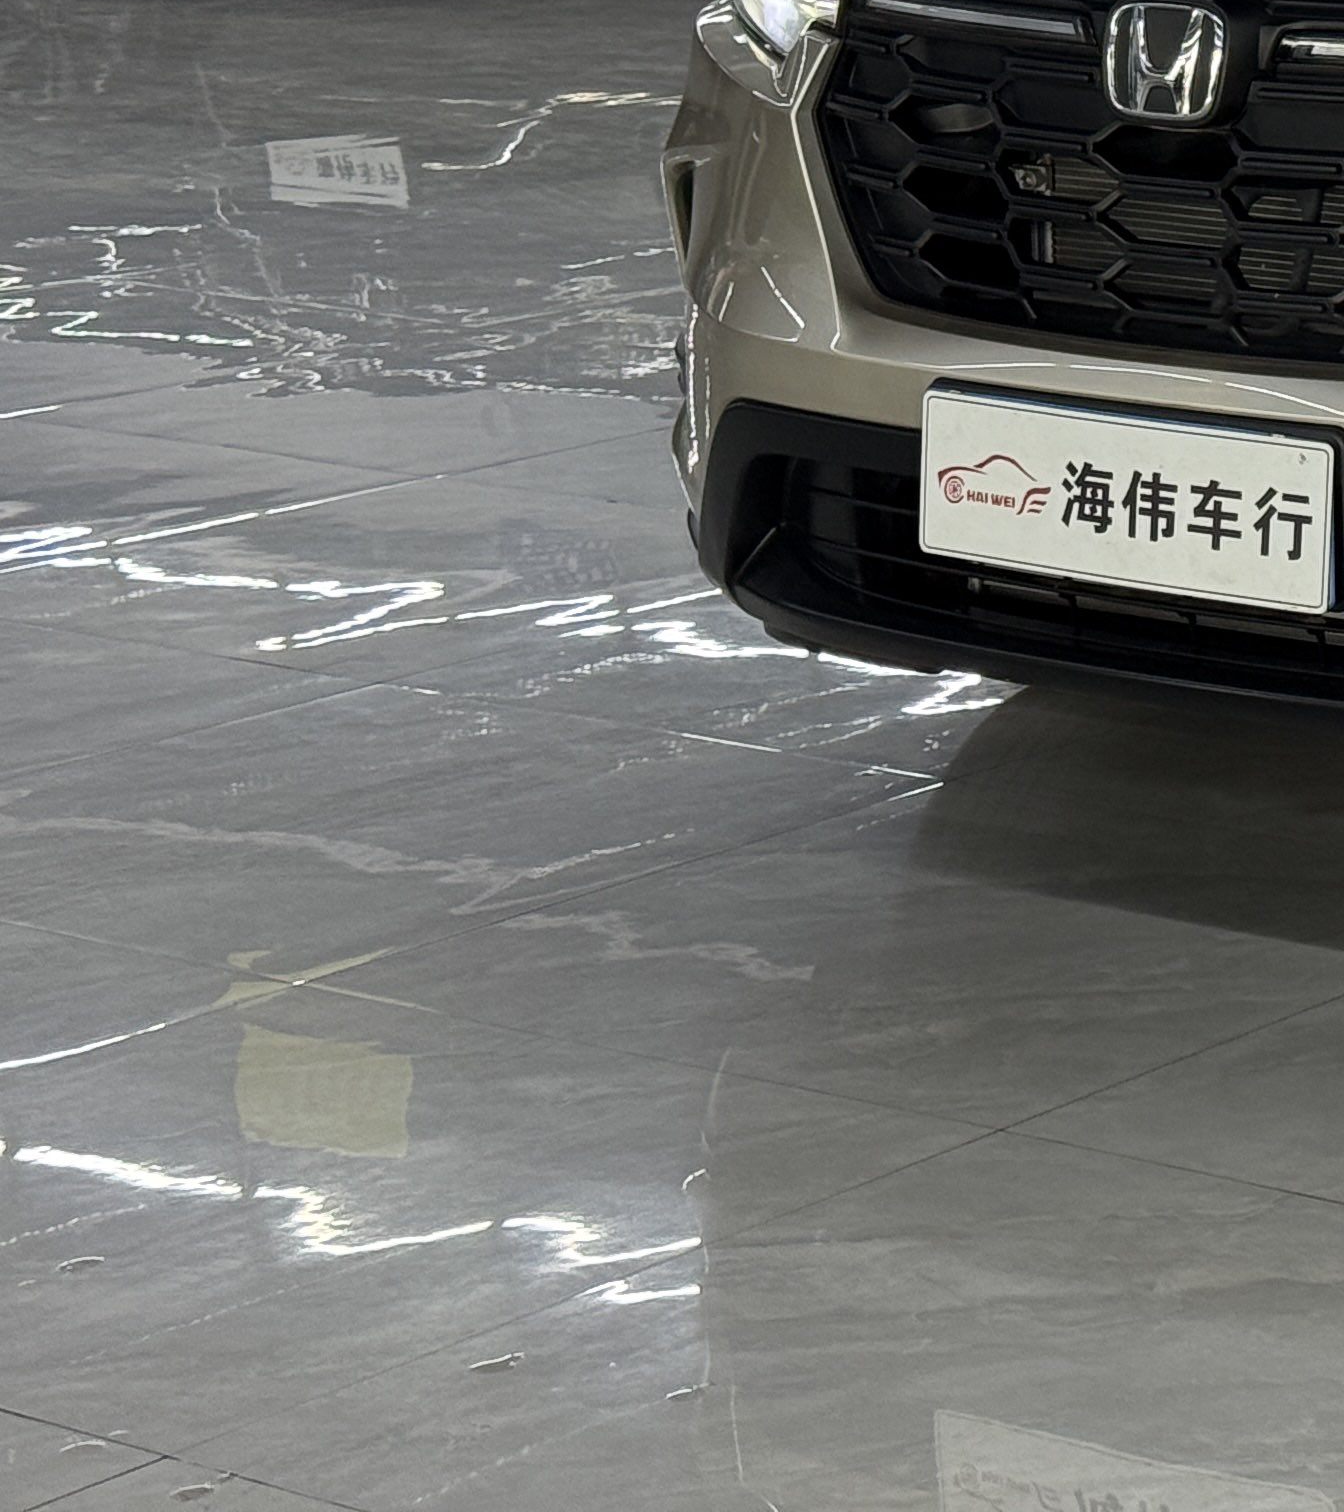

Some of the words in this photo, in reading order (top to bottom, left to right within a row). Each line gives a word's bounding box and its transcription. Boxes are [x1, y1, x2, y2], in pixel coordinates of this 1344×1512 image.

[991, 492, 1016, 510] WEI
[1061, 460, 1314, 561] 海伟车行
